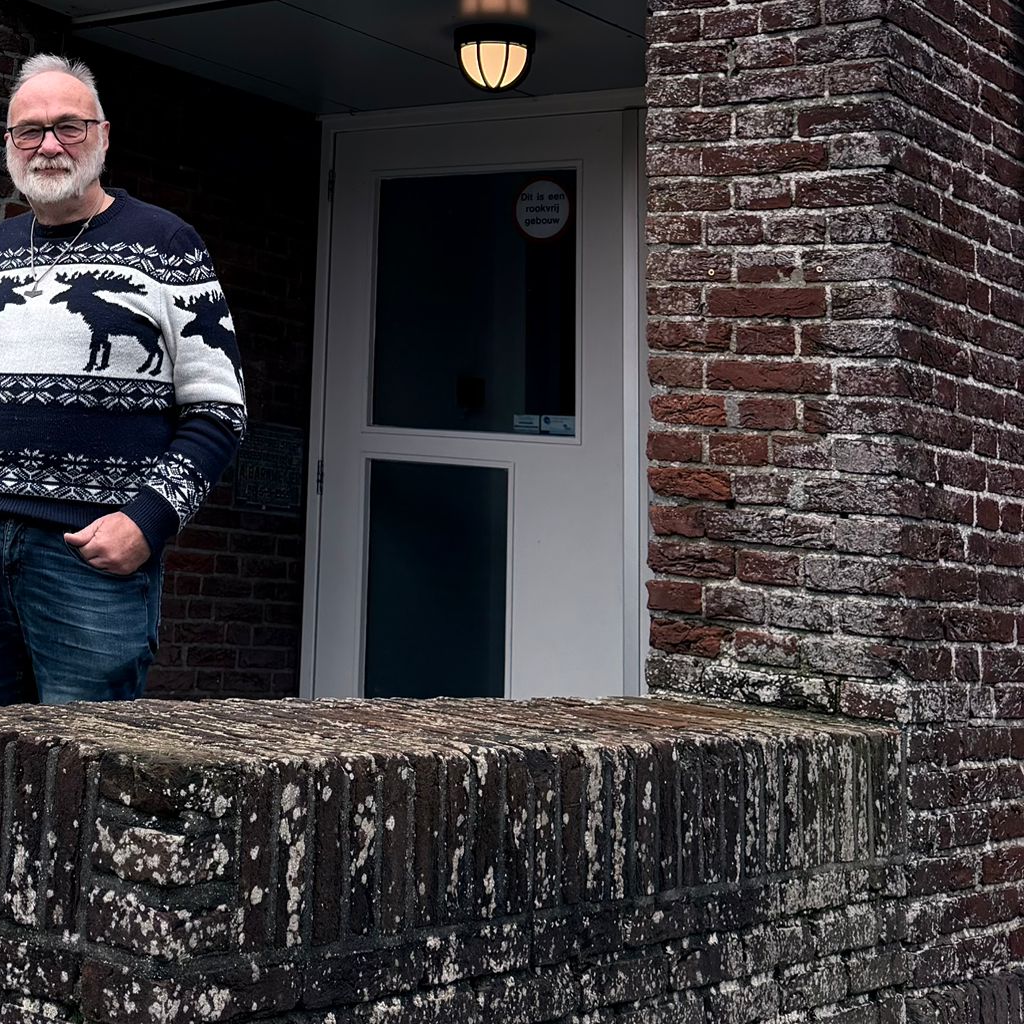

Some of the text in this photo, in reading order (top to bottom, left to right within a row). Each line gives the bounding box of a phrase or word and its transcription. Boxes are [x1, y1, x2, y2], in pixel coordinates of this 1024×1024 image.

[520, 192, 565, 201] Dit is een
[525, 203, 560, 213] rookvrij
[524, 217, 560, 227] gebouw
